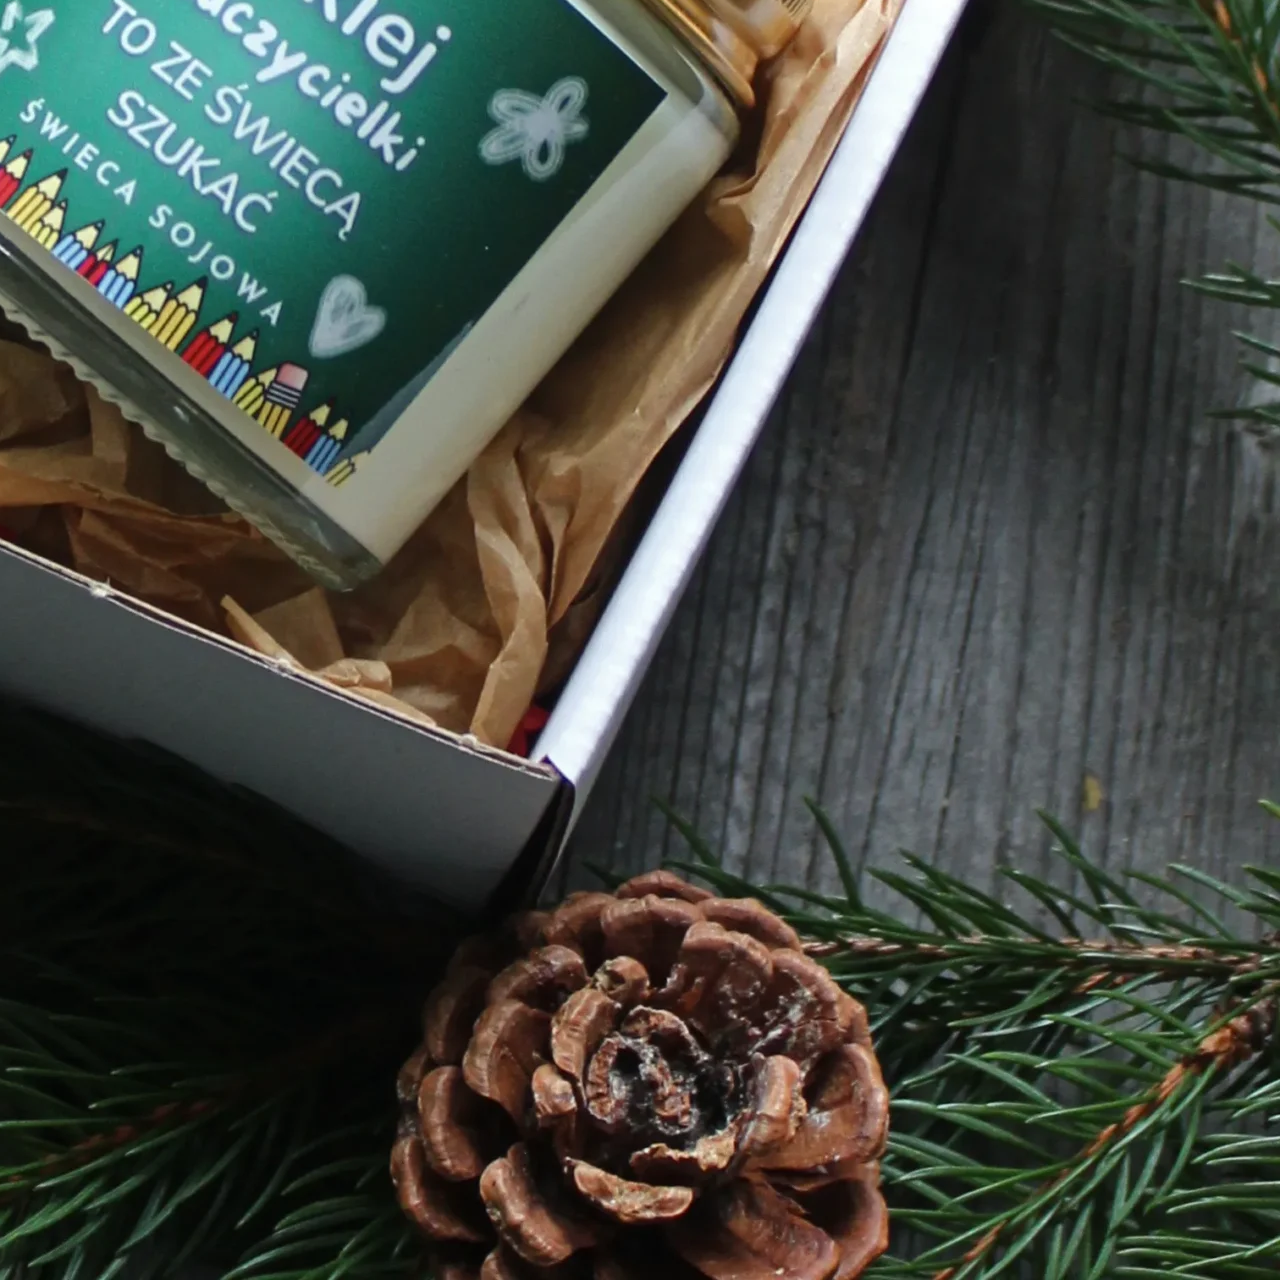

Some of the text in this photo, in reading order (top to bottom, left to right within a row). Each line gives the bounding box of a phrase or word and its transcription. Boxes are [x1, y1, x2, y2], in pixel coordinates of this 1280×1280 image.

[19, 98, 284, 326] ŚWIECA SOJOWA
[107, 90, 278, 232] SZUKAĆ
[150, 40, 212, 100] ZE
[205, 82, 362, 241] ŚWIECĄ
